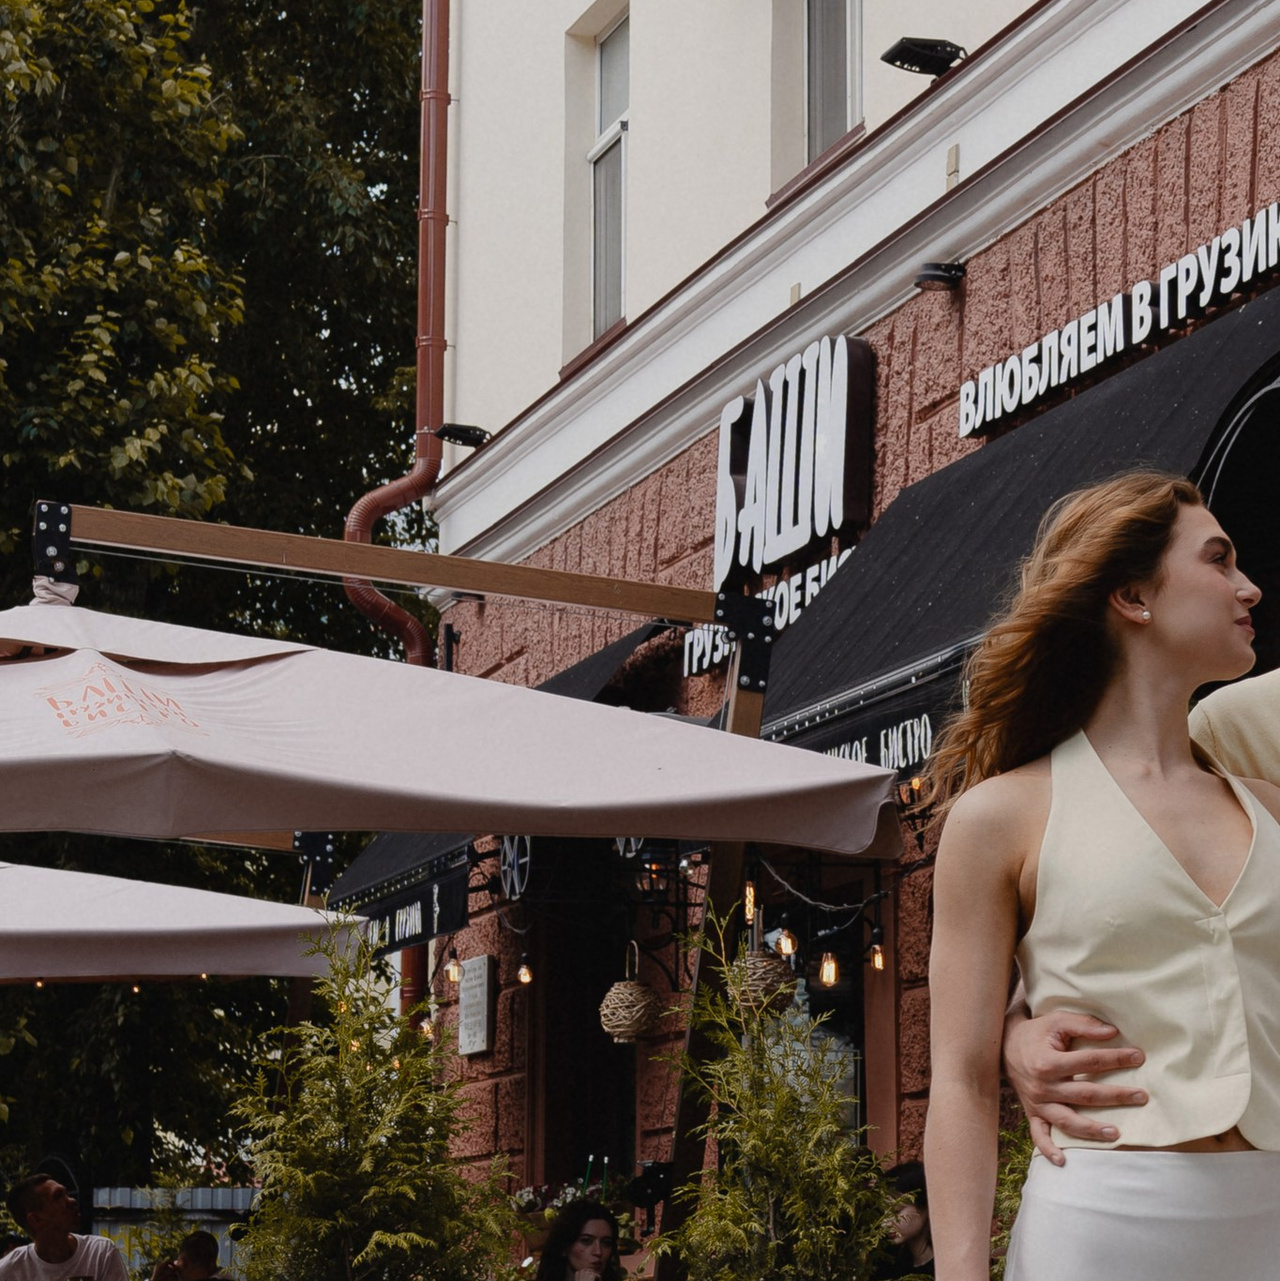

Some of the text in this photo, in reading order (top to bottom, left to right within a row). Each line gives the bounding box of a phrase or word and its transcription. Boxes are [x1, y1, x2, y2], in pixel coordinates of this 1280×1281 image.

[959, 293, 1124, 439] ВЛЮБЛЯЕМ
[1131, 280, 1152, 345] В
[713, 334, 849, 593] БАШИ
[880, 713, 932, 770] БИСТРО
